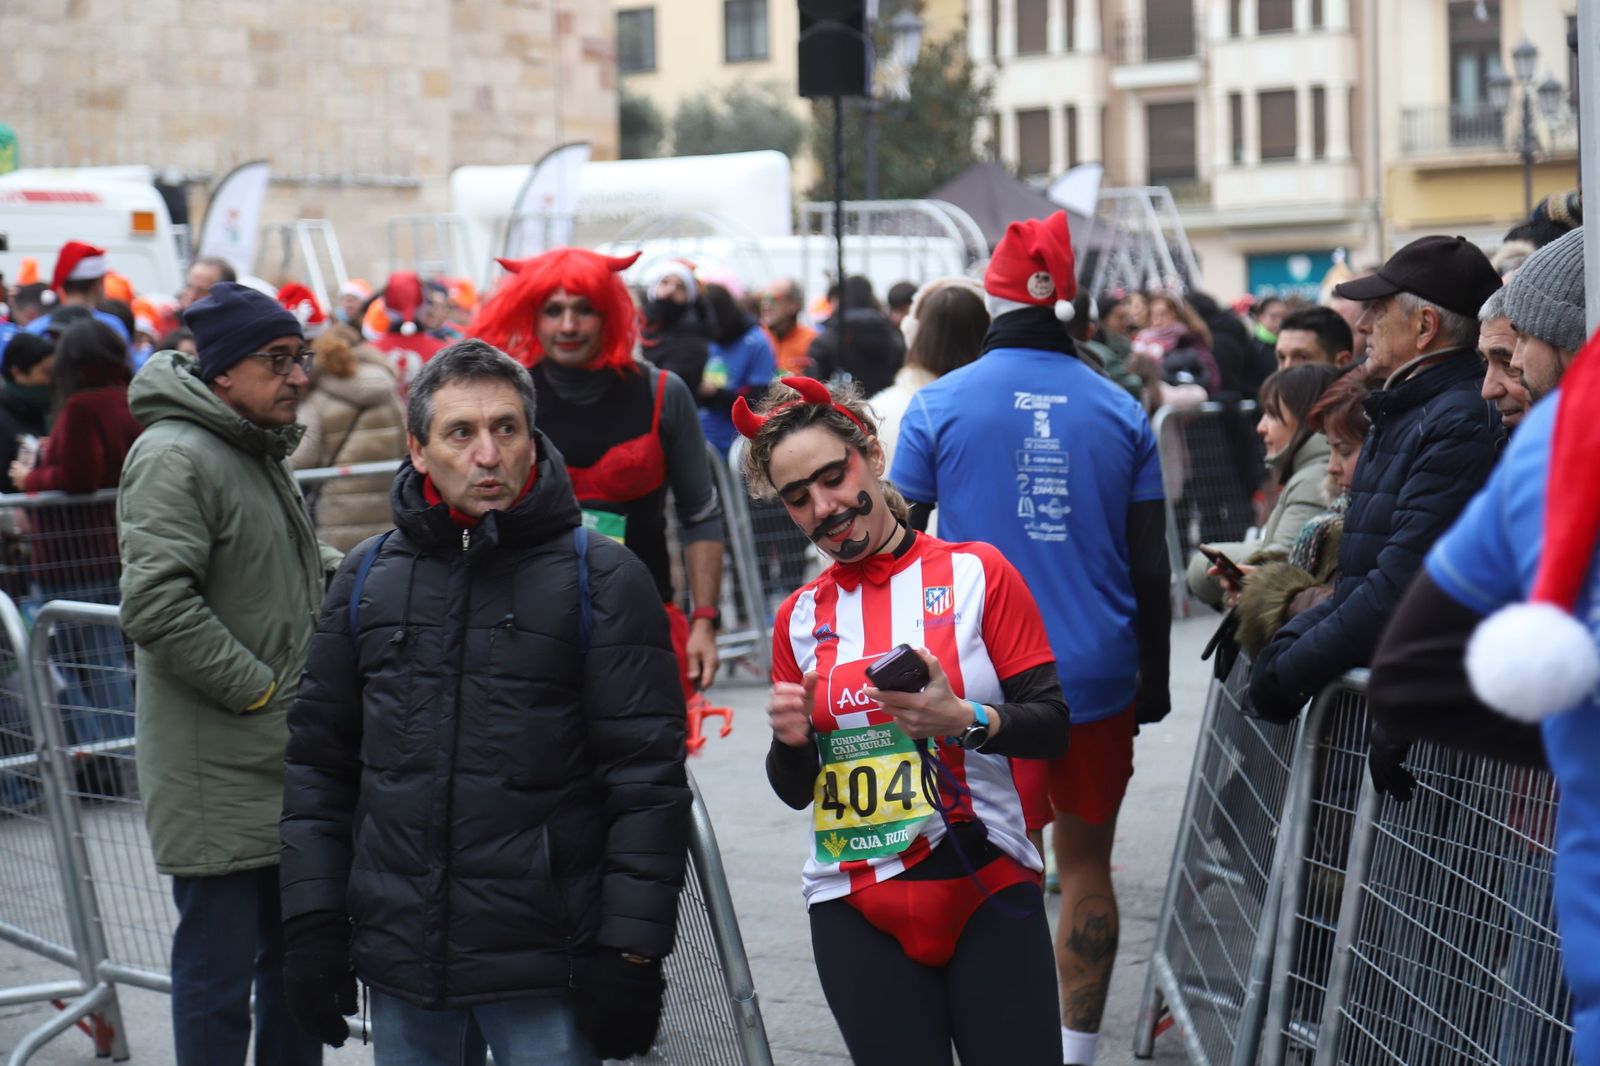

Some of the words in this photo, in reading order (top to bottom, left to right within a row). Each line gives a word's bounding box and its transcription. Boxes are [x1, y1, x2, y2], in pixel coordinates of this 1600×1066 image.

[836, 683, 880, 709] Ad
[832, 745, 859, 755] CAJA
[859, 737, 895, 751] RURAL
[822, 760, 917, 820] 404
[850, 834, 883, 850] CAJA
